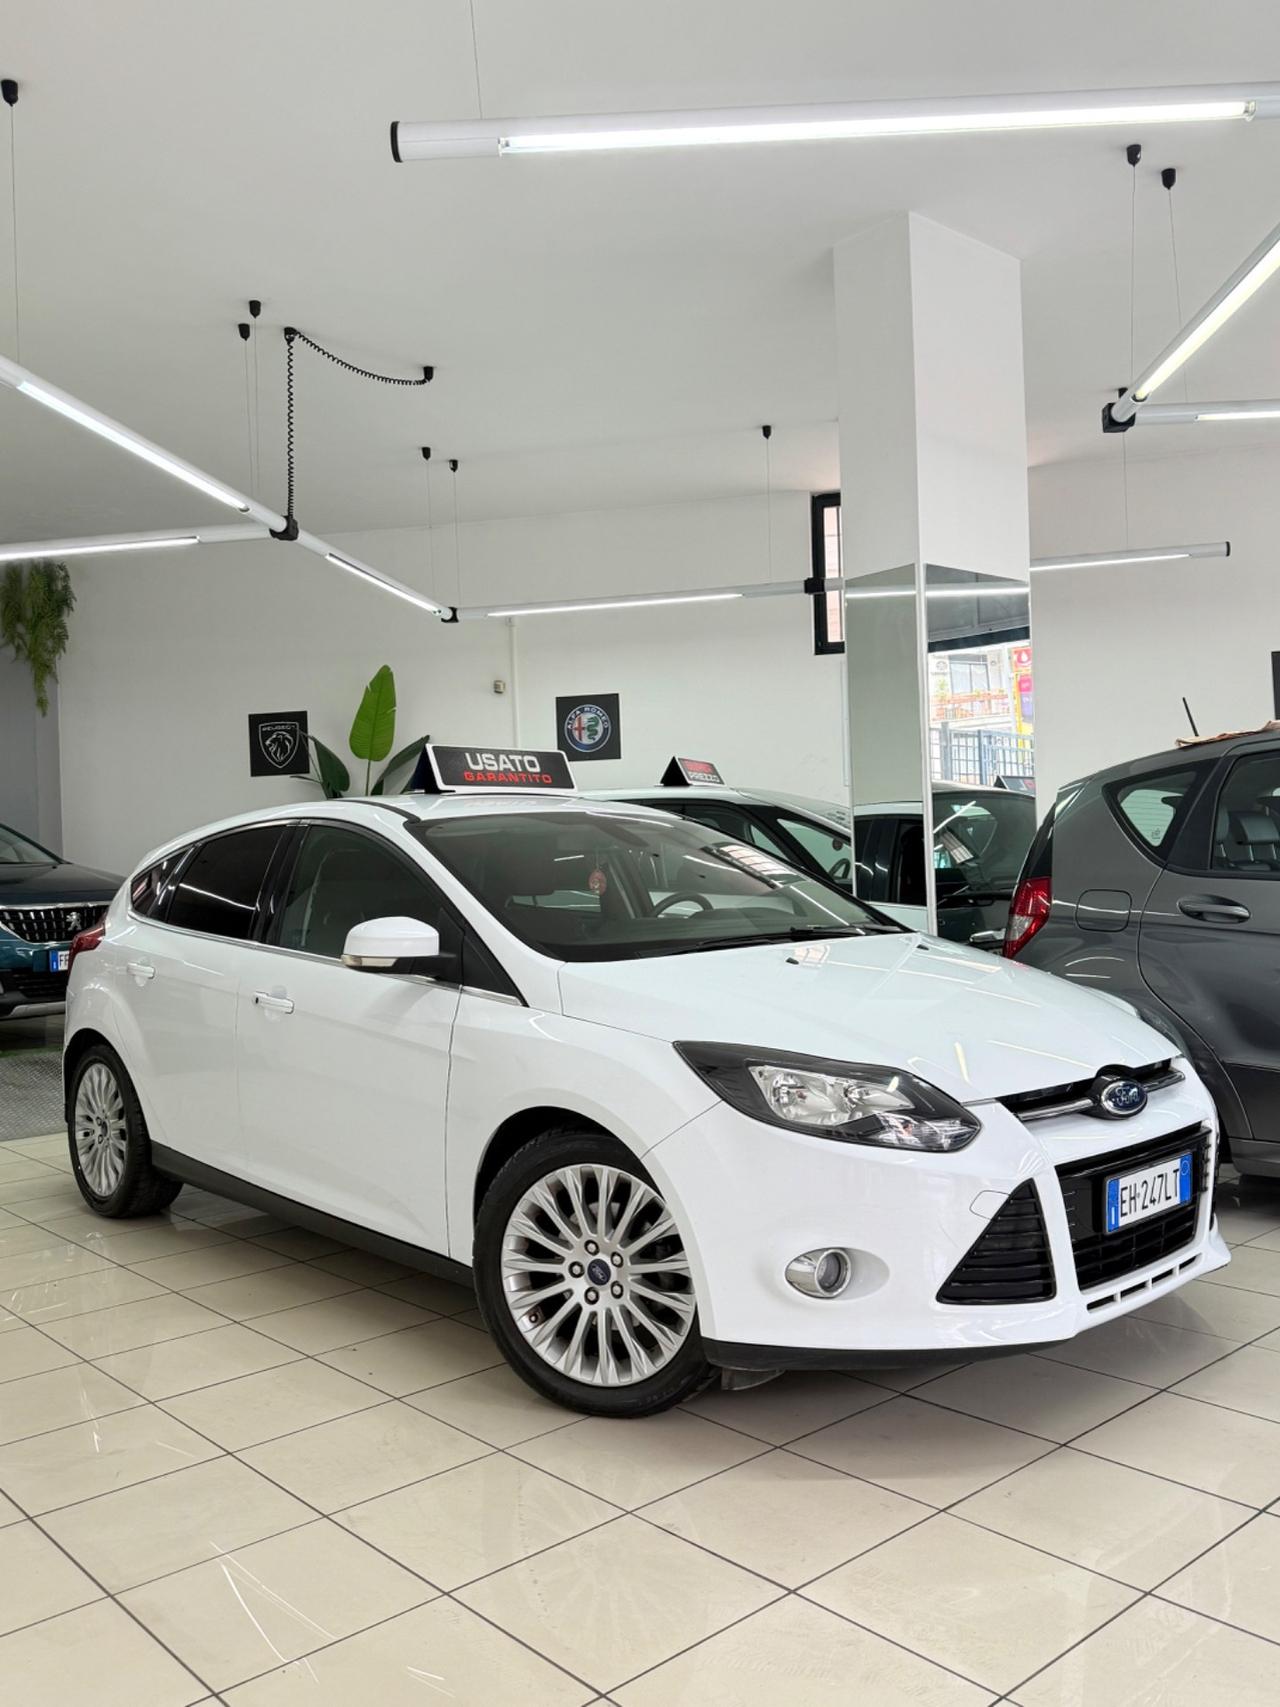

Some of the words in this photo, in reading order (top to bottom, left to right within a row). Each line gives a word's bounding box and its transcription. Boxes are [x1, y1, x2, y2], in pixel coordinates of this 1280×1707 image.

[567, 710, 581, 730] ALFA
[584, 707, 609, 729] ROMEO
[464, 752, 541, 773] USATO
[463, 770, 553, 784] GARANTITO
